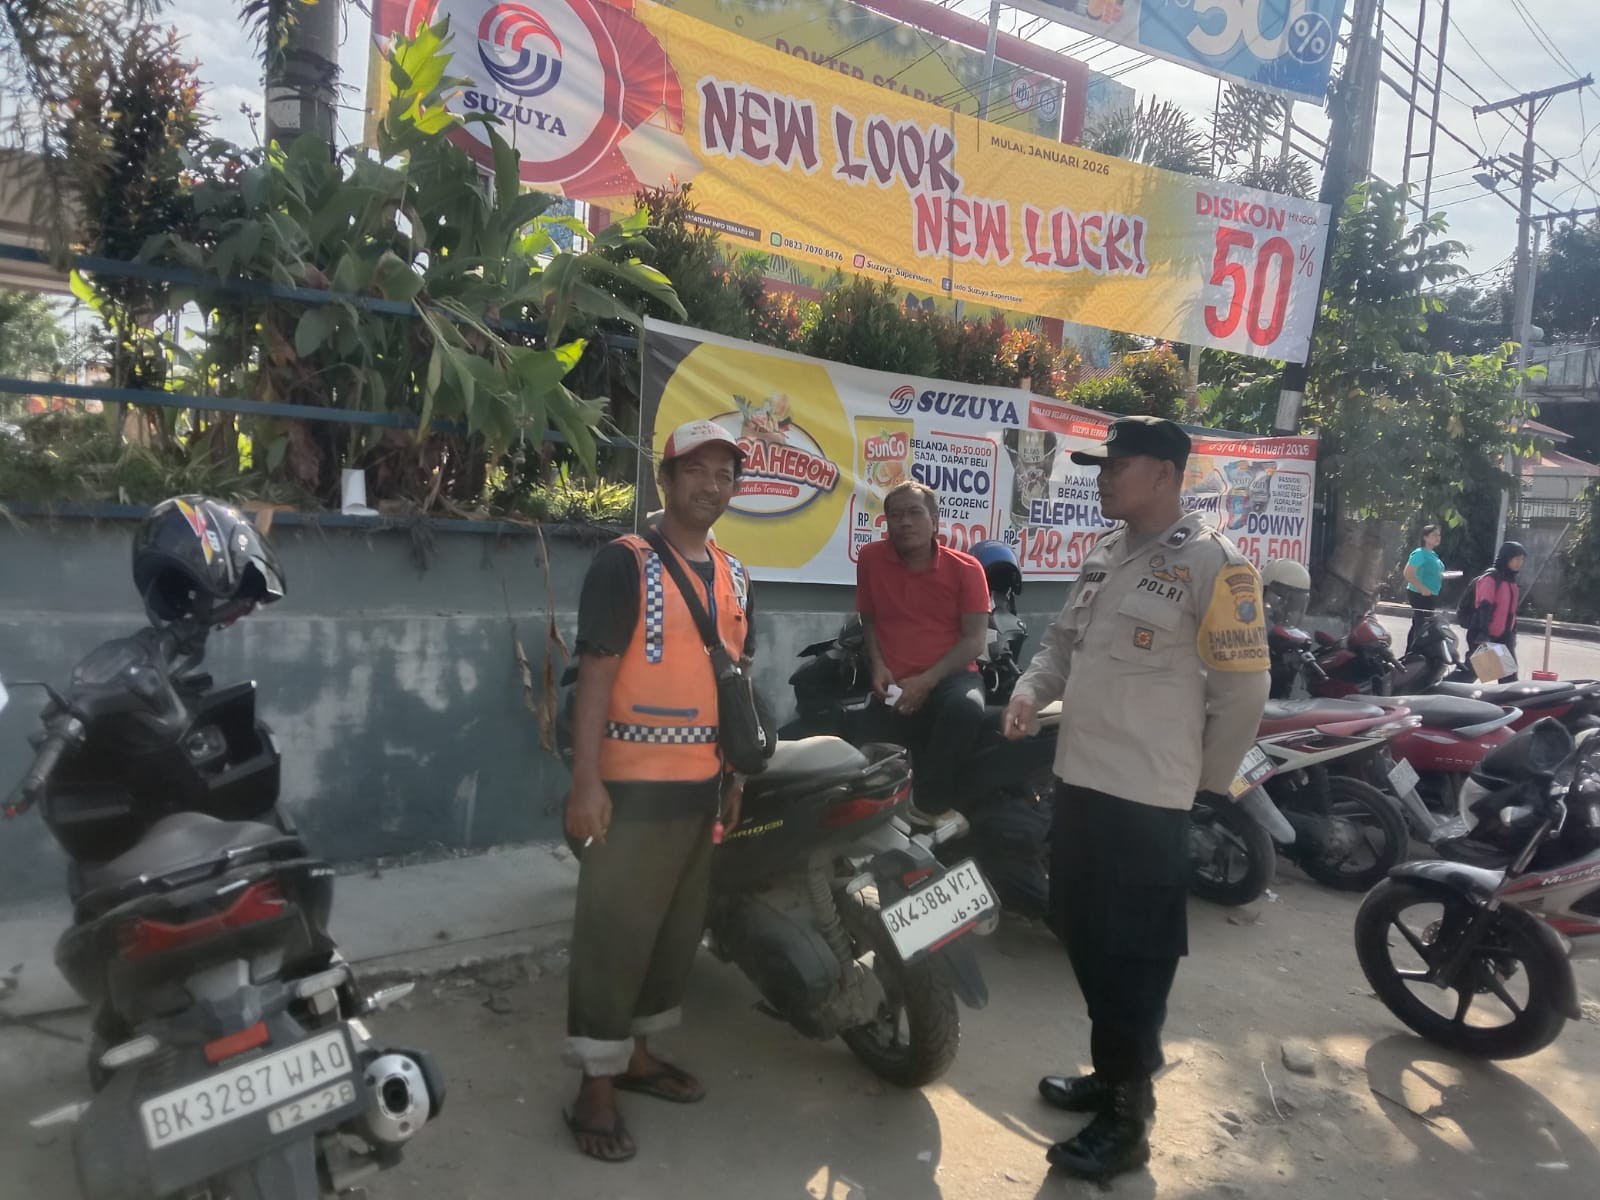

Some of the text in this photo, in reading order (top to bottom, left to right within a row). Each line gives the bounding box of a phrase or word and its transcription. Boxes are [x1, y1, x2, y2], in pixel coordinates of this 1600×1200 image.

[463, 90, 567, 136] SUZUYA
[701, 81, 959, 193] NEW LOOK
[1028, 145, 1080, 168] JANUARI
[1082, 158, 1110, 176] 2026
[1196, 191, 1285, 231] DISKON
[914, 193, 1146, 274] NEW LUCK!
[805, 245, 823, 256] 7070
[824, 250, 843, 261] 8476
[1204, 226, 1315, 346] 50 %
[917, 390, 1019, 425] SUZUYA
[867, 436, 905, 458] SunCo
[910, 438, 992, 457] BELANJA Rp.50.000
[1249, 442, 1284, 456] Januari
[769, 445, 836, 487] HEBOH
[941, 454, 968, 466] DAPAT
[970, 458, 988, 467] BELI
[911, 463, 990, 495] SUNCO
[949, 496, 989, 509] GORENG
[1058, 488, 1089, 500] BERAS
[858, 512, 870, 526] RP
[952, 510, 957, 519] 2
[960, 509, 970, 520] Lt
[1248, 513, 1304, 537] DOWNY
[854, 533, 872, 543] POUCH
[1004, 530, 1015, 544] RP
[1137, 578, 1183, 602] POLRI
